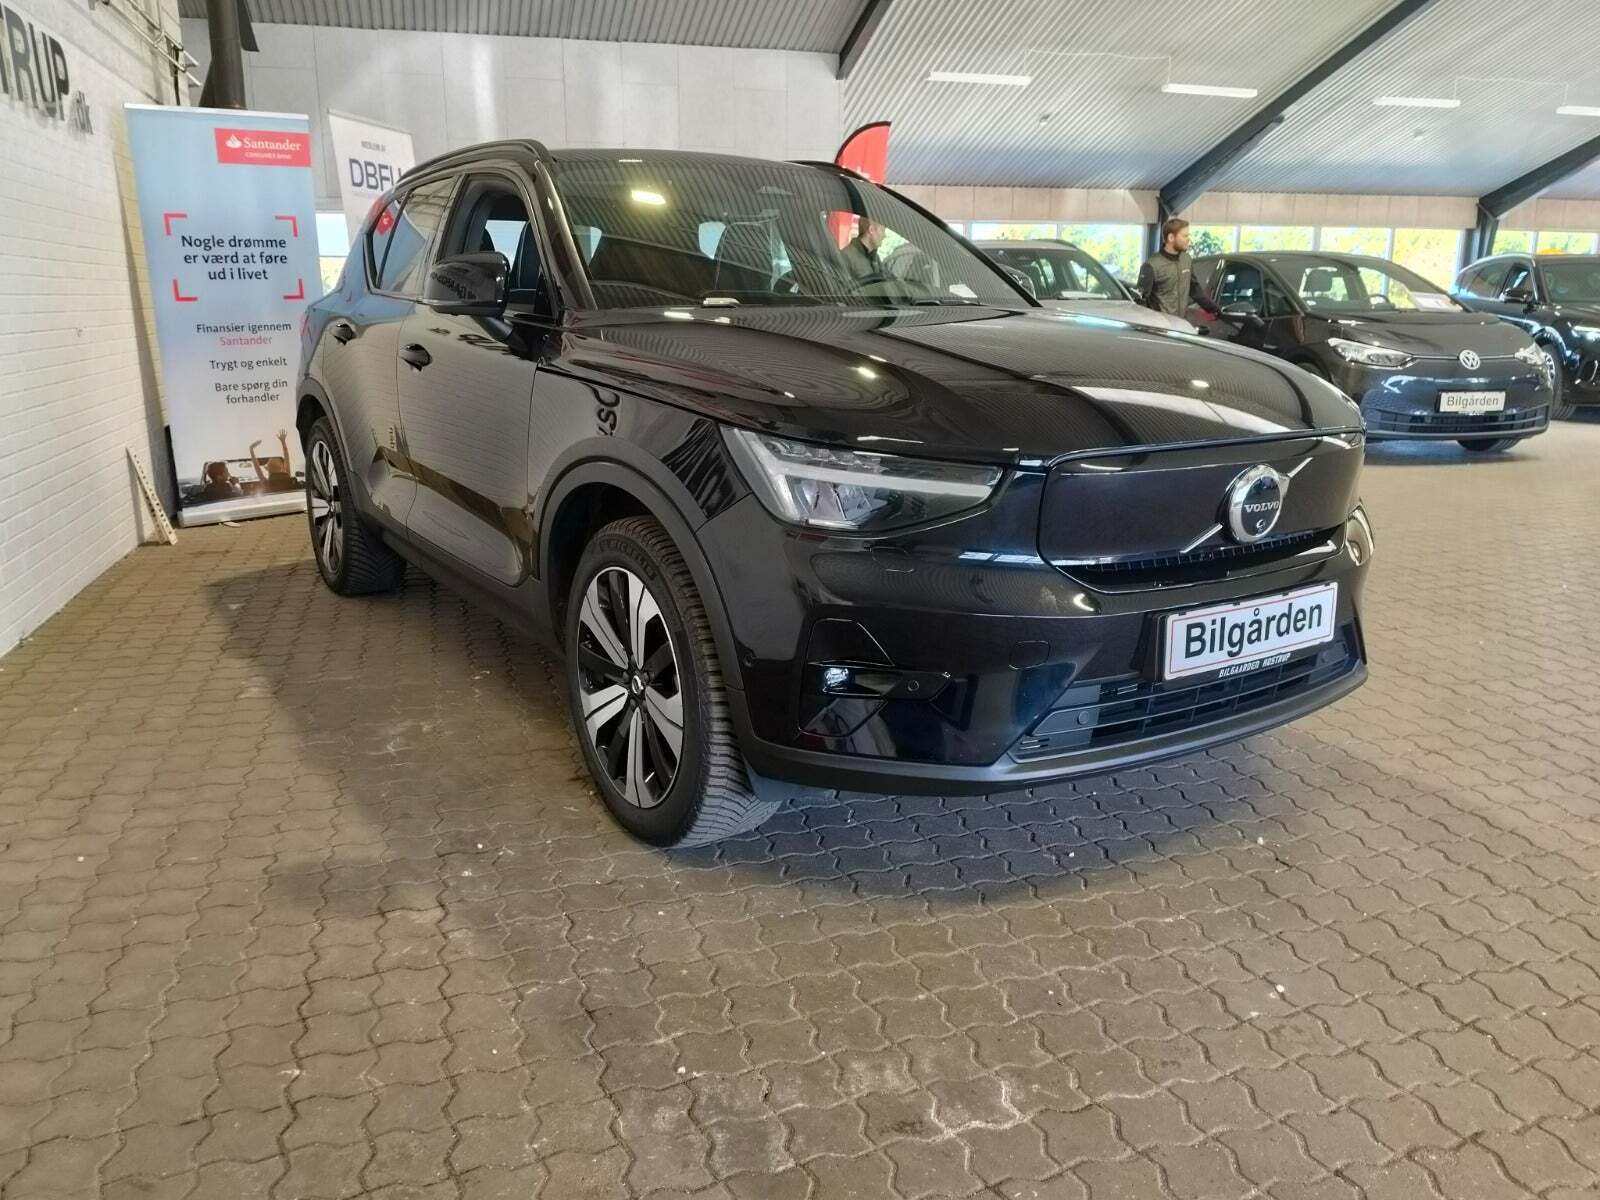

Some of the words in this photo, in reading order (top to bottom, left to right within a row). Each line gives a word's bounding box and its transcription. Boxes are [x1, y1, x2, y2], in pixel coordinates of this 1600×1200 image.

[243, 137, 301, 151] Santander
[181, 235, 225, 251] Nogle
[228, 235, 287, 248] drømme
[183, 254, 198, 264] er
[201, 251, 239, 264] værd
[243, 253, 256, 264] at
[259, 251, 288, 264] føre
[208, 267, 226, 280] ud
[230, 267, 234, 280] i
[238, 267, 269, 280] livet
[196, 323, 245, 333] Finansier
[248, 323, 292, 334] igennem
[220, 336, 273, 346] Santander
[209, 359, 239, 371] Trygt
[240, 360, 254, 370] og
[256, 356, 288, 367] enkelt
[215, 382, 239, 392] Bare
[241, 381, 271, 392] spørg
[272, 379, 288, 389] din
[226, 393, 280, 404] forhandler
[1244, 501, 1280, 512] VOLVO
[1184, 602, 1323, 659] Bilgården
